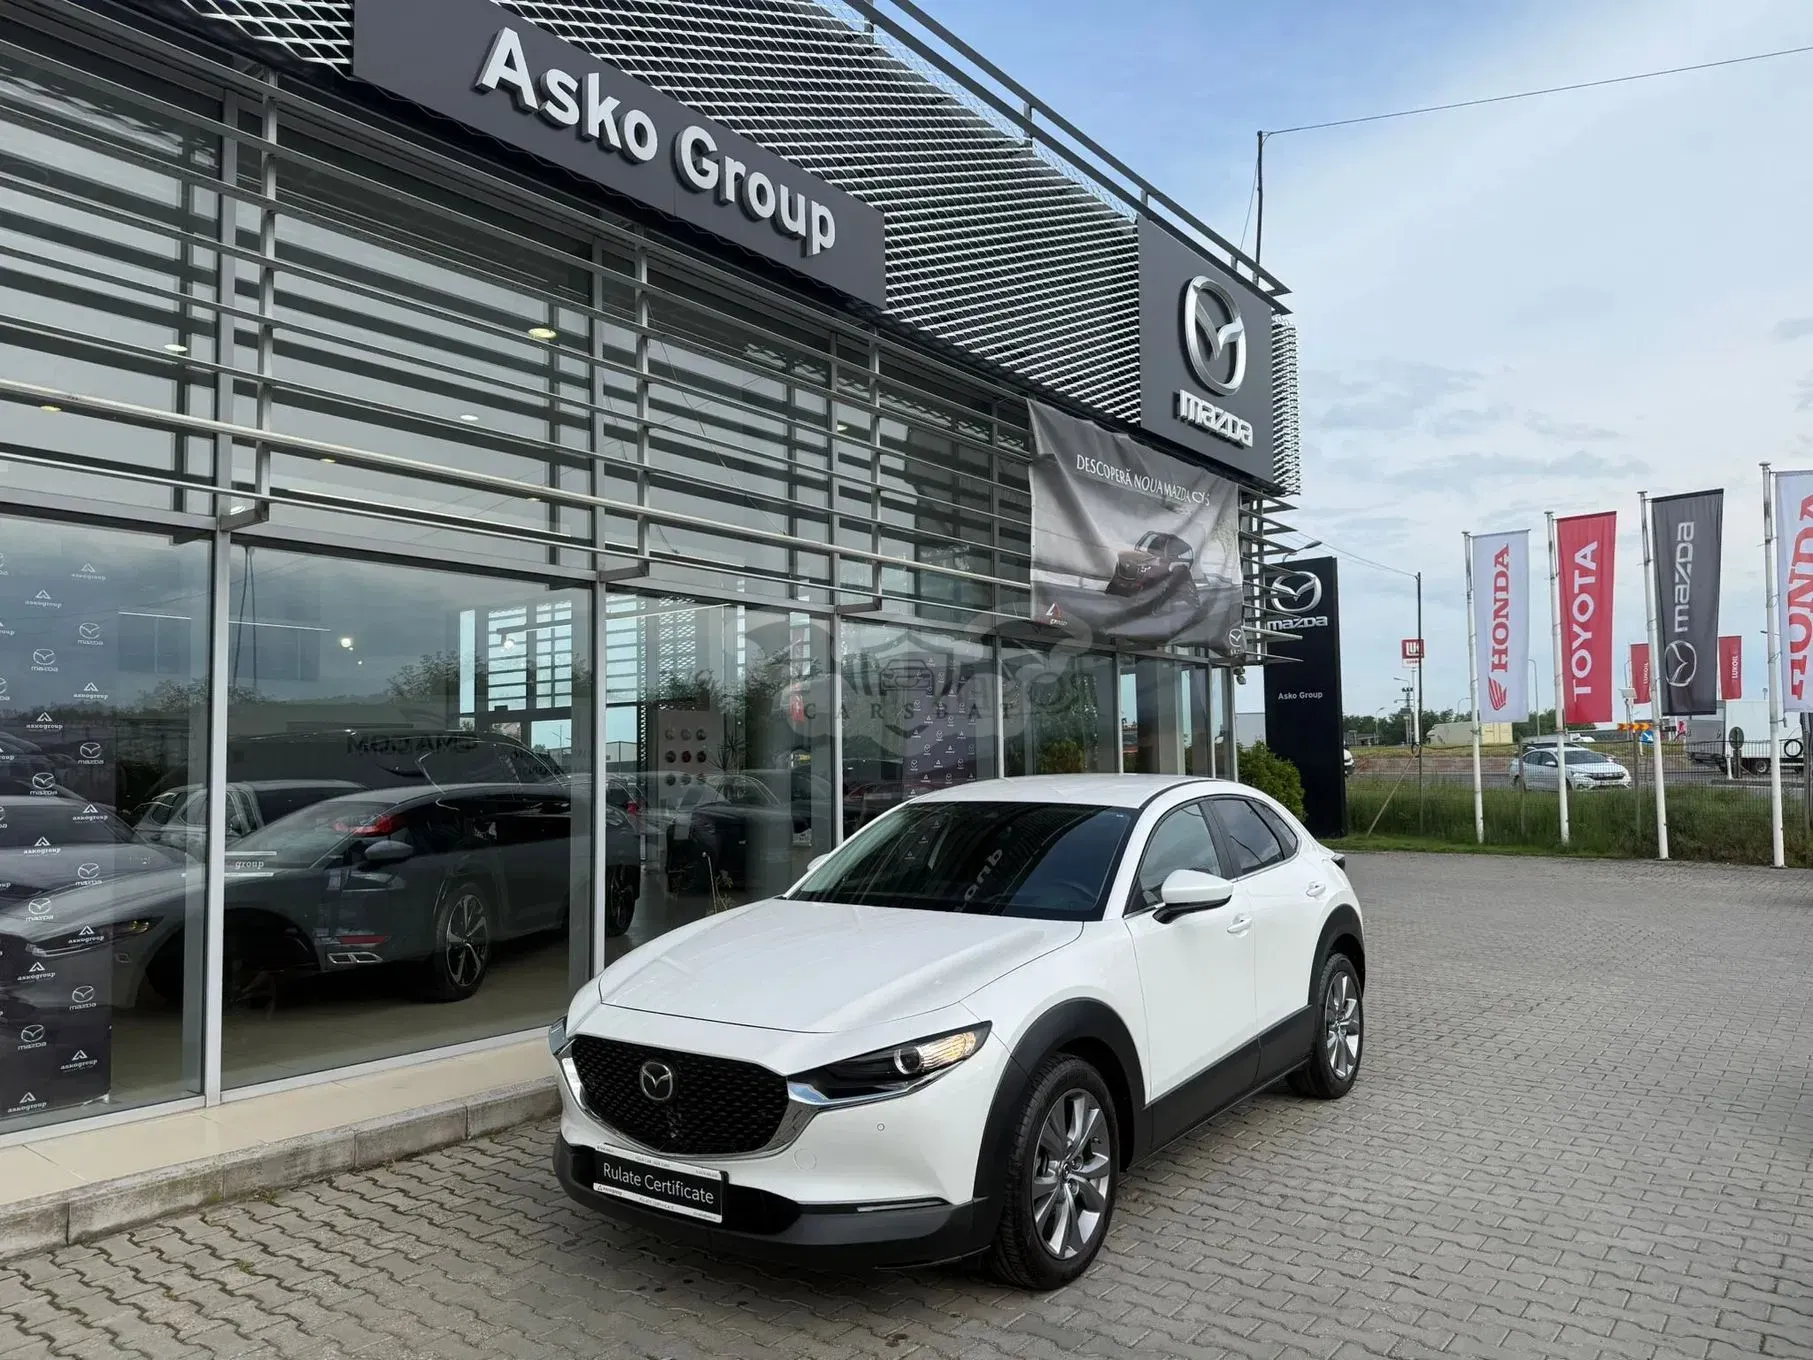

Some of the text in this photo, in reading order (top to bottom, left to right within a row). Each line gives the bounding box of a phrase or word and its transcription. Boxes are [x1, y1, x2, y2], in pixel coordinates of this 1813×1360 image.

[474, 26, 836, 257] Asko Group
[1178, 388, 1254, 448] mazda
[1076, 454, 1132, 487] DESCOPERĂ
[1132, 473, 1163, 496] NOUA
[1674, 520, 1695, 633] mazda
[1266, 616, 1328, 631] mazda
[1490, 543, 1511, 674] HONDA
[1572, 539, 1600, 703] TOYOTA
[1731, 655, 1739, 679] LUKOIL
[1278, 691, 1323, 700] Asko Group
[602, 1162, 642, 1187] Rulate
[644, 1174, 715, 1205] Certificate
